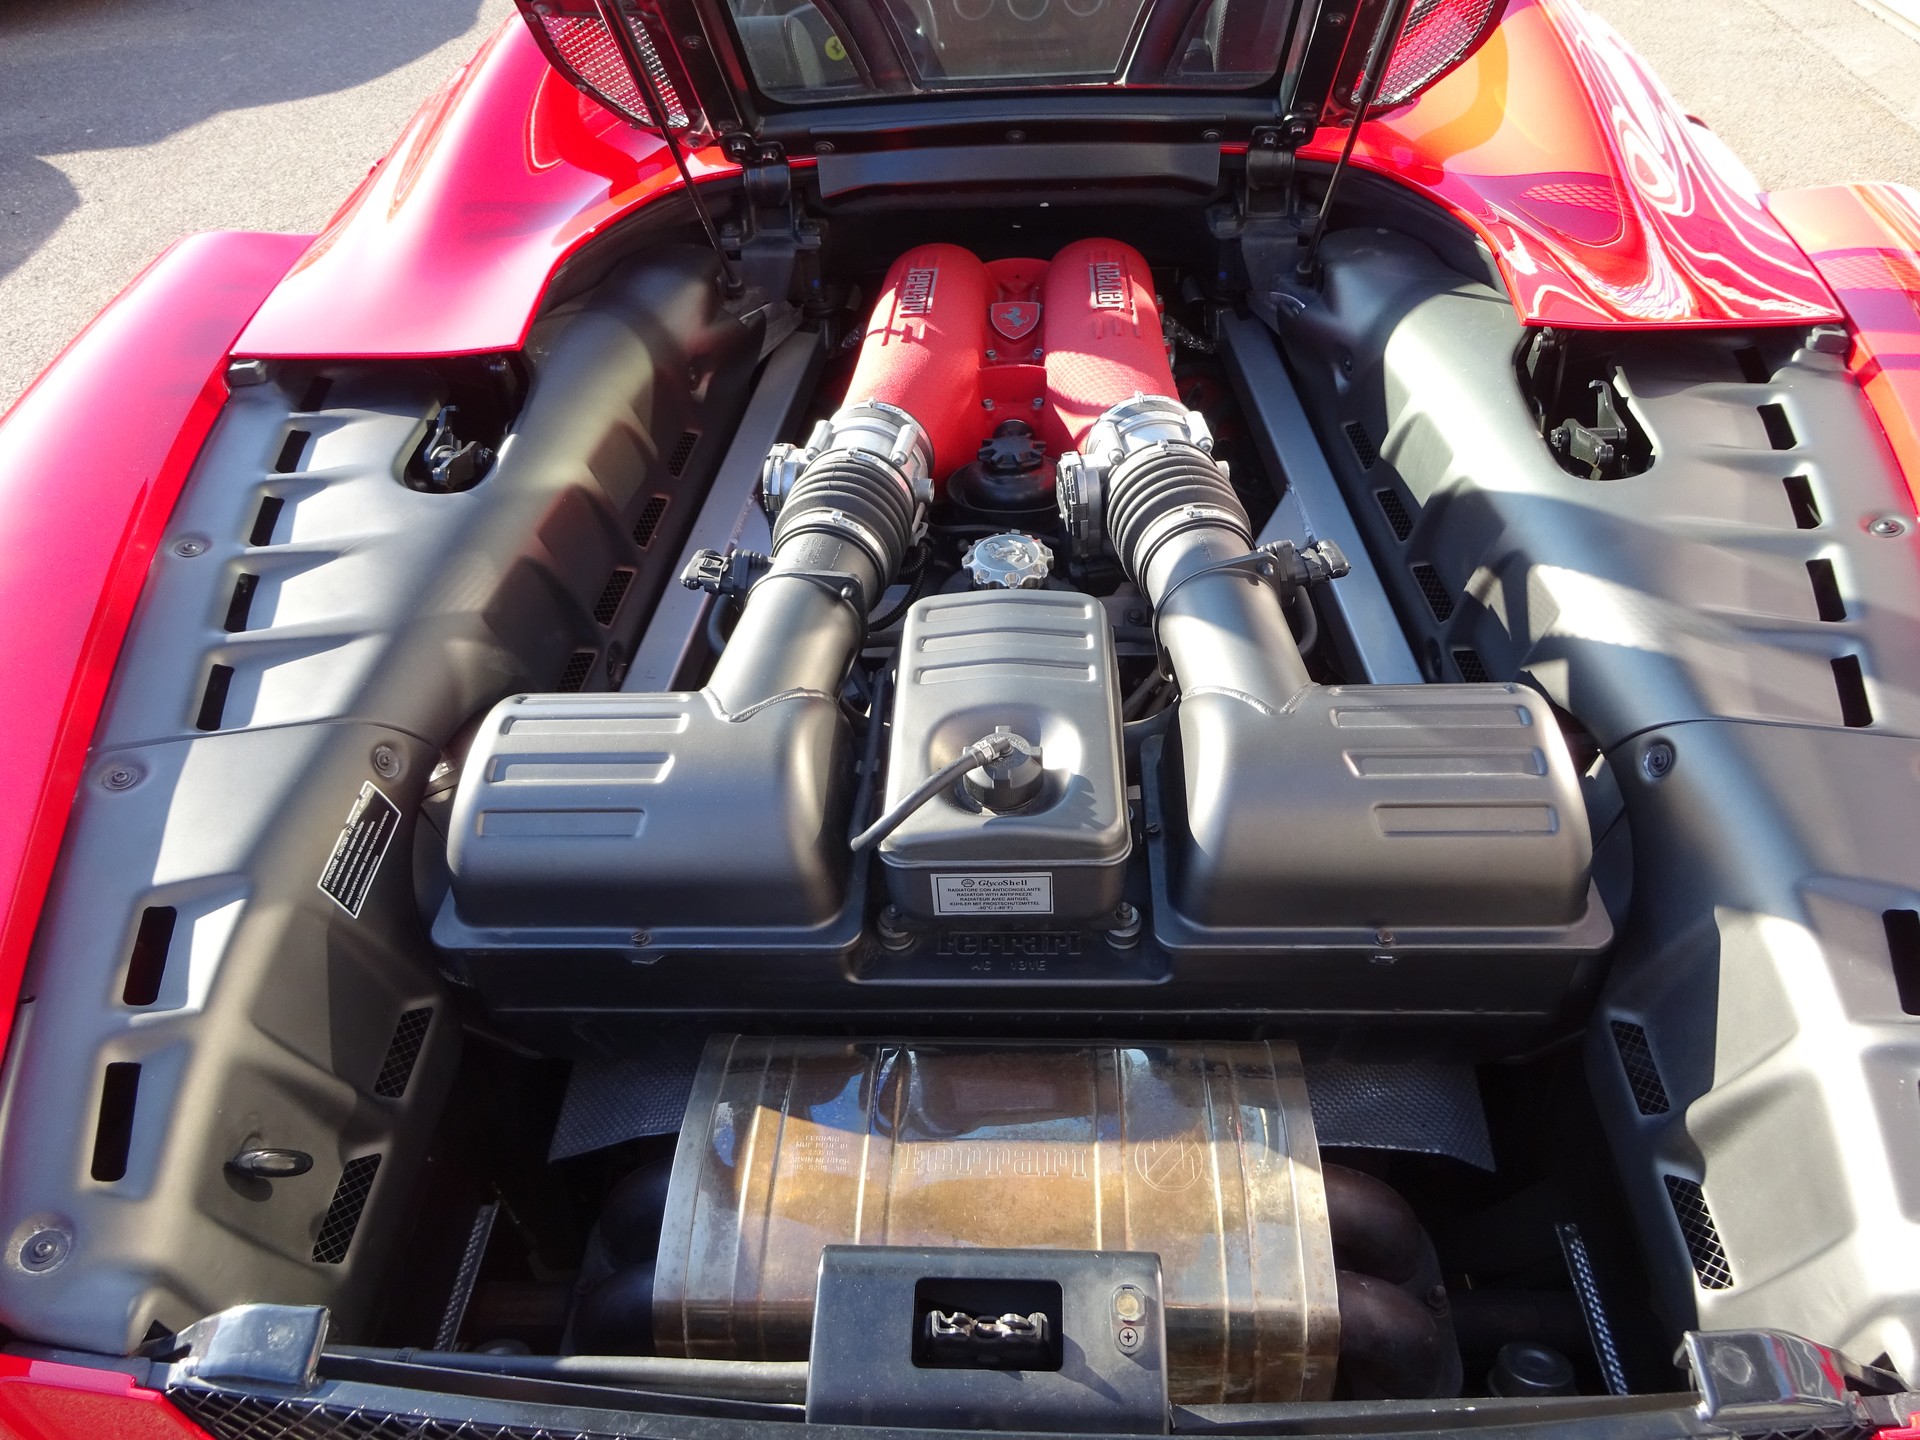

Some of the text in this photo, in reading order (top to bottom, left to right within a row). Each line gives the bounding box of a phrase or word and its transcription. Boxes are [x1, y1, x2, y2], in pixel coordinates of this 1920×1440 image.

[899, 267, 939, 314] Ferrari
[1089, 262, 1125, 309] Ferrari
[323, 859, 339, 887] ATTENZIONE
[337, 836, 349, 856] CAUTION
[978, 879, 1028, 887] GlycoShell
[936, 930, 1082, 955] Ferrari
[971, 960, 992, 971] AC
[897, 1142, 1087, 1178] Ferrari
